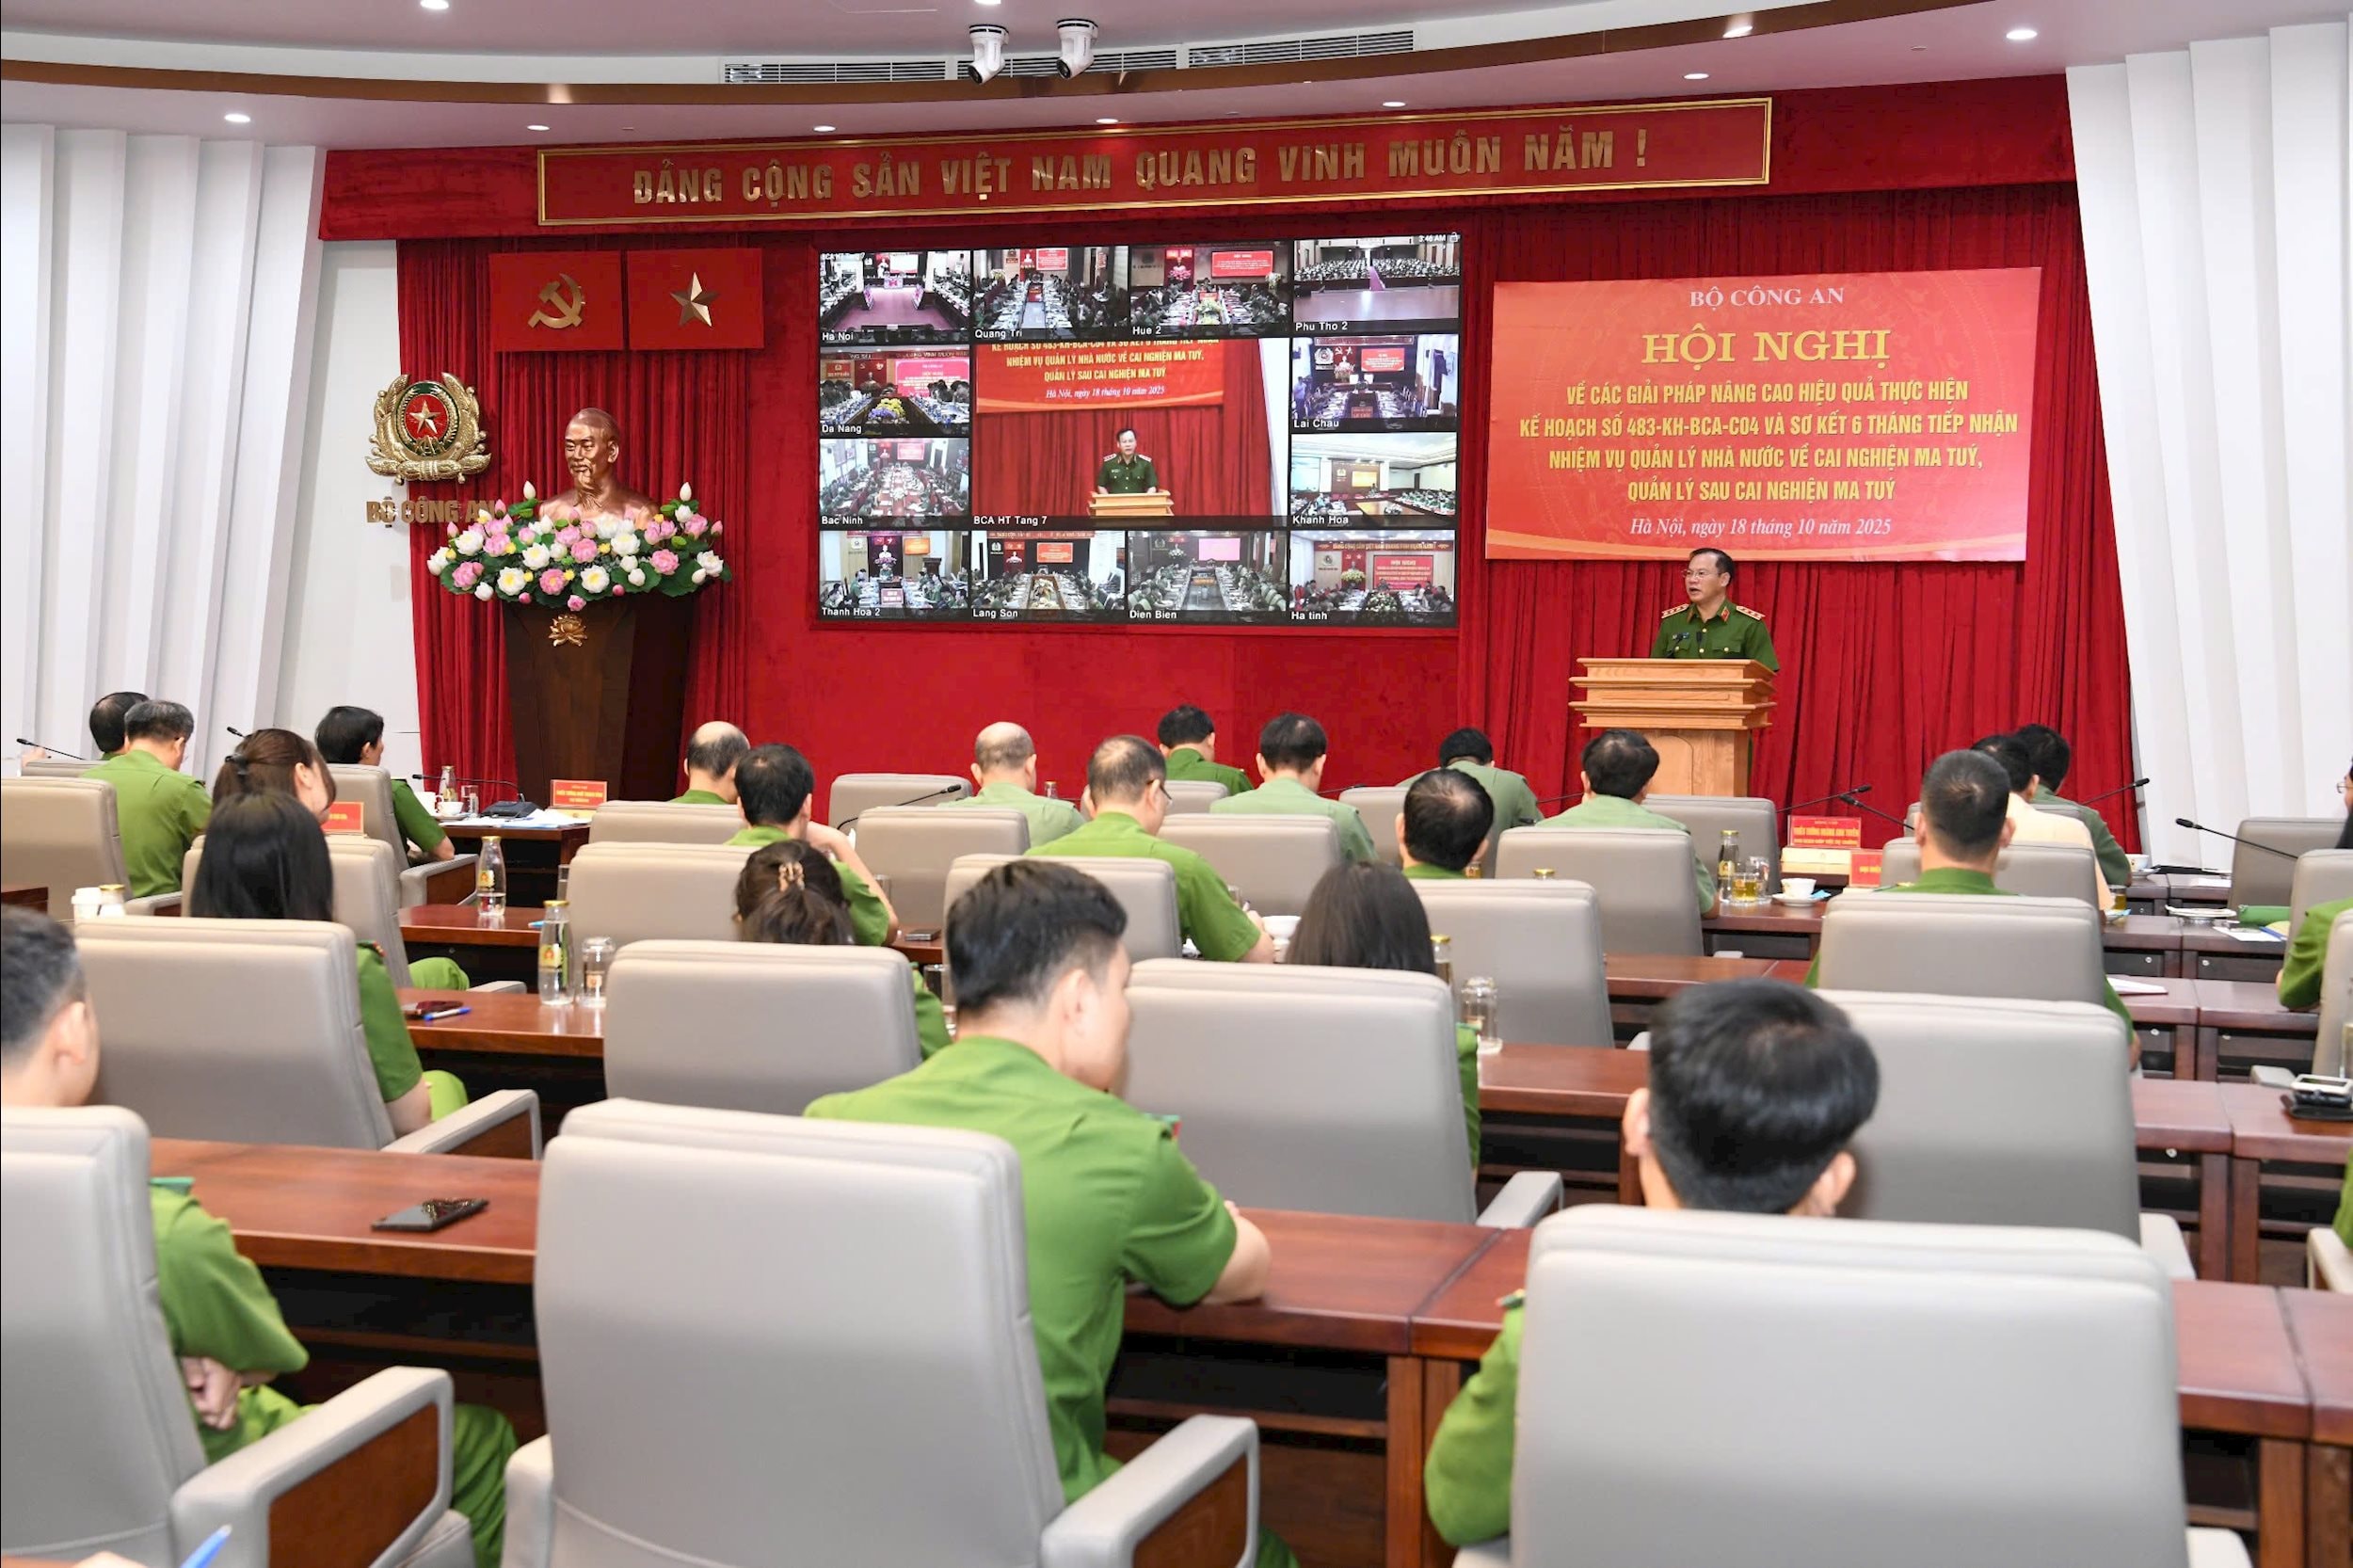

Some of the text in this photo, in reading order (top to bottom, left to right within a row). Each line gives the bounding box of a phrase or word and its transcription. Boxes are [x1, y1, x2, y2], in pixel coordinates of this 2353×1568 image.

[633, 124, 1647, 207] ĐẢNG CỘNG SẢN VIỆT NAM QUANG VINH MUÔN NĂM !
[1689, 284, 1845, 311] BỘ CÔNG AN
[1132, 326, 1161, 335] Hue 2
[1295, 322, 1348, 331] Phu Tho 2
[822, 331, 854, 341] Ha Noi
[975, 328, 1022, 340] Quang Tri
[1641, 323, 1890, 371] HỘI NGHỊ
[1006, 355, 1032, 368] NHIỆM
[1129, 352, 1143, 362] CAI
[1144, 349, 1172, 363] NGHIỆN
[1174, 351, 1186, 360] MA
[1078, 371, 1092, 380] SAU
[1094, 369, 1107, 379] CAI
[1109, 367, 1137, 380] NGHIỆN
[1138, 368, 1150, 378] MA
[1567, 376, 1969, 406] VỀ CÁC GIẢI PHÁP NÂNG CAO HIỆU QUẢ THỰC HIỆN
[1294, 419, 1339, 428] Lai Chau
[1520, 408, 2018, 441] KẾ HOẠCH SỐ 483-KH-BCA-C04 VÀ SƠ KẾT 6 THÁNG TIẾP NHẬN
[823, 424, 862, 435] Da Nang
[1549, 442, 1983, 472] NHIỆM VỤ QUẢN LÝ NHÀ NƯỚC VỀ CAI NGHIỆN MA TUÝ,
[1628, 475, 1896, 504] QUẢN LÝ SAU CAI NGHIỆN MA TUÝ
[366, 496, 395, 528] BỘ
[401, 495, 459, 523] CÔNG
[822, 516, 863, 525] Bac Ninh
[974, 516, 1047, 527] BCA HT Tang 7
[1293, 516, 1348, 525] Khanh Hoa
[1630, 518, 1891, 538] Hà Nội, ngày 18 tháng 10 năm 2025
[823, 607, 881, 616] Thanh Hoa 2
[973, 609, 1018, 620] Lang Son
[1129, 610, 1176, 619] Dien Bien
[1291, 612, 1327, 621] Ha tinh
